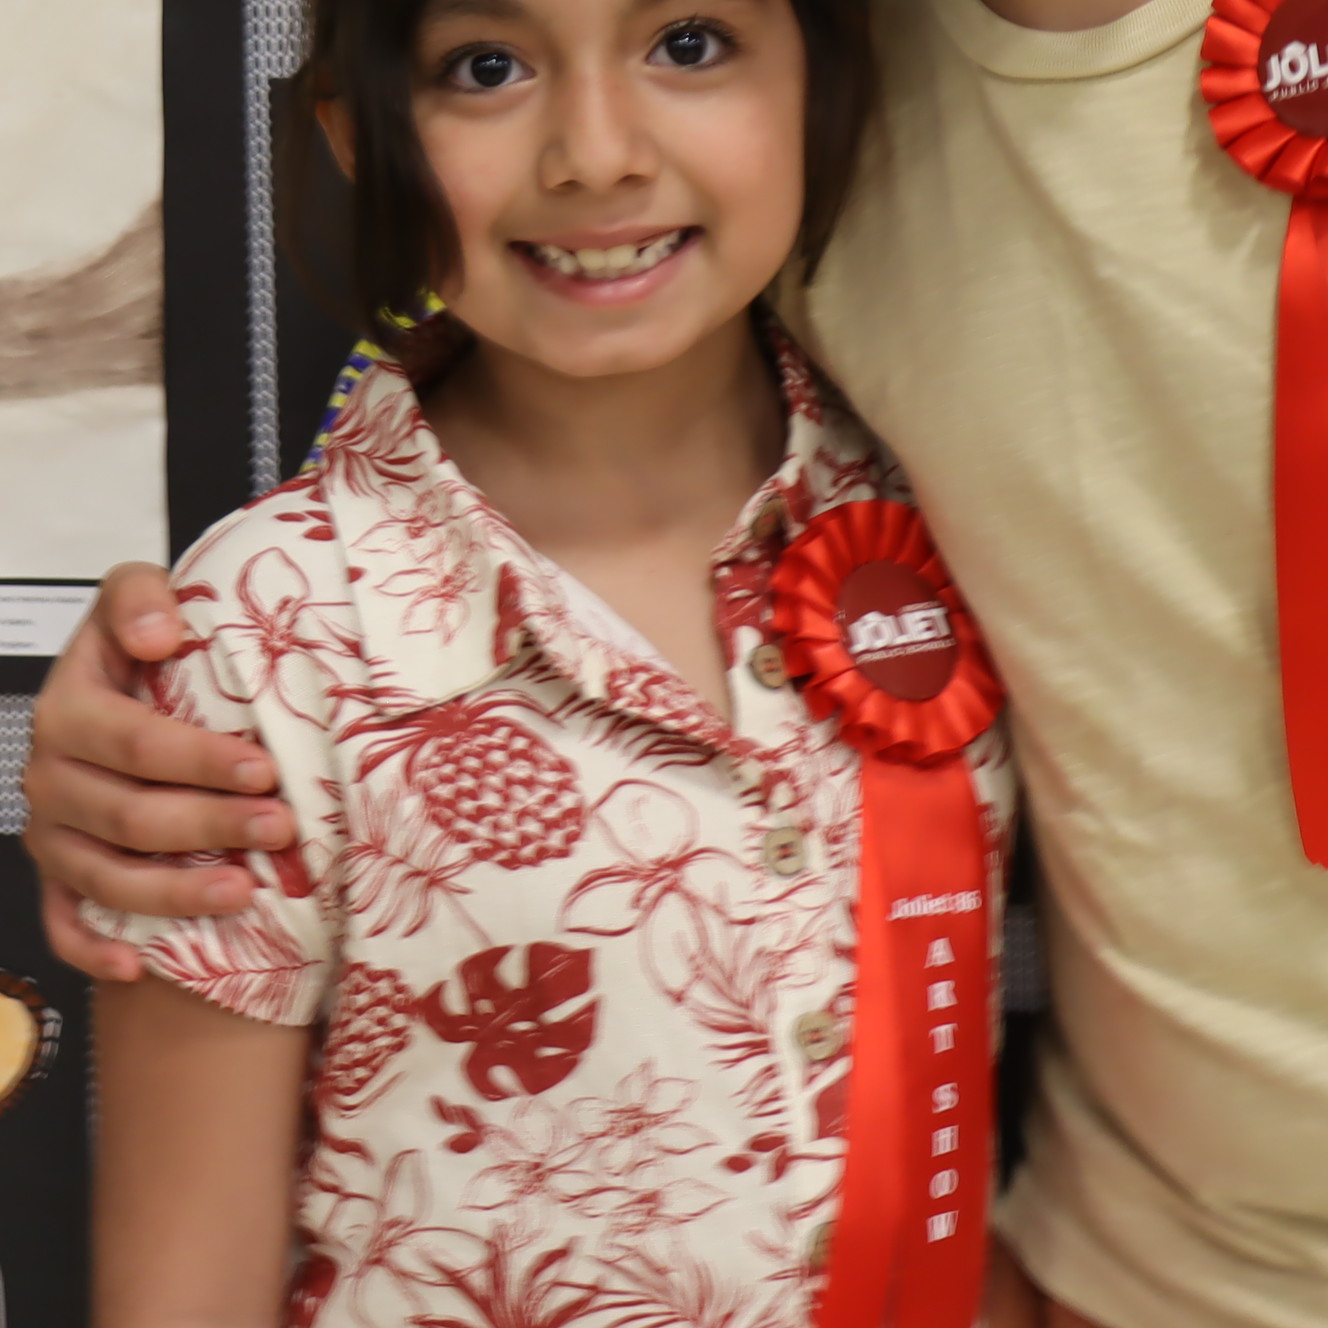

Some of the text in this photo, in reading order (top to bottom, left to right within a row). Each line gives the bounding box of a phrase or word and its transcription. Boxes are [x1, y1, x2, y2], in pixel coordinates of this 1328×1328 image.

[1269, 78, 1320, 103] PUBLIC
[924, 936, 960, 1055] ART
[925, 1081, 960, 1244] SHOW
